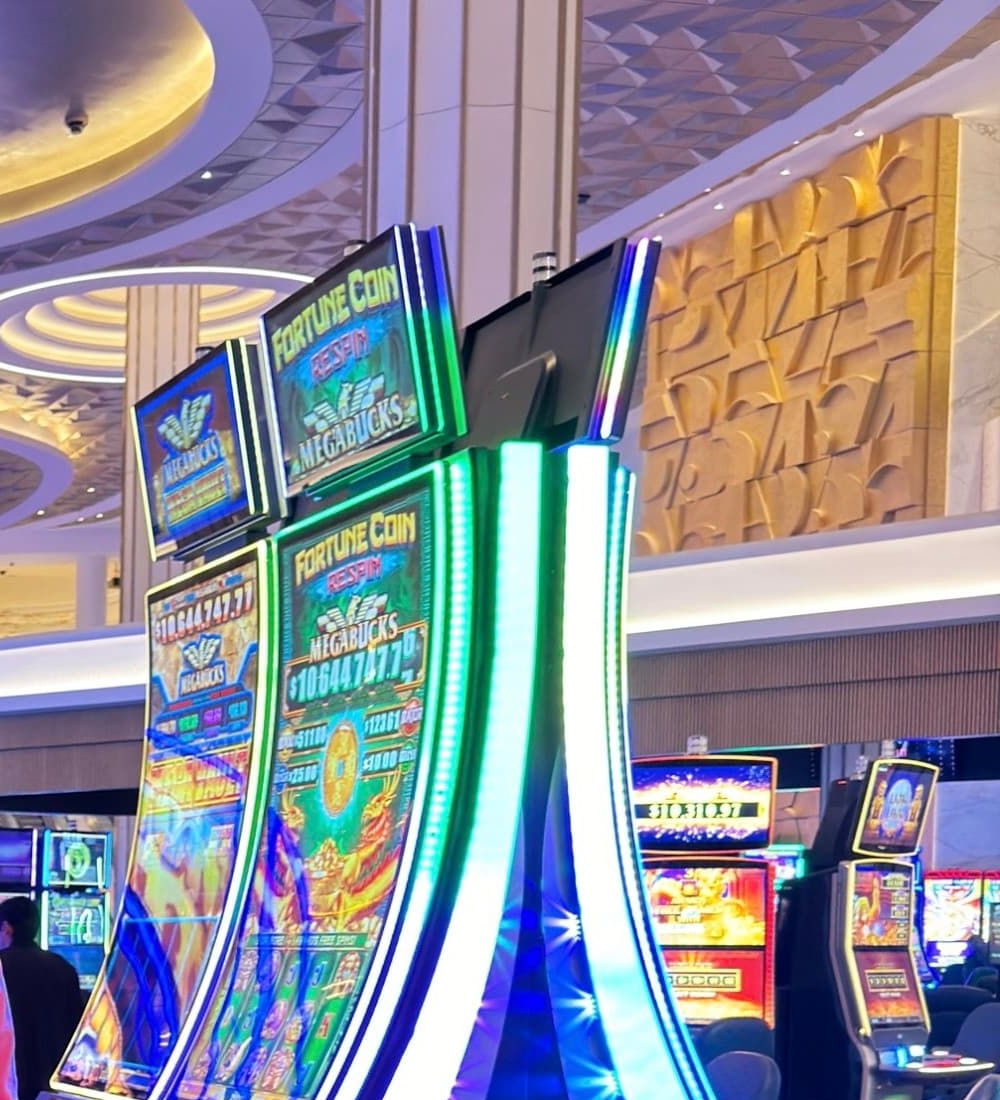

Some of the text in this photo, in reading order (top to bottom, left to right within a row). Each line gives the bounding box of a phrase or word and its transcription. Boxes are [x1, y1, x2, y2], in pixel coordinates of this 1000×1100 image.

[272, 266, 399, 372] FORTUNE COIN
[299, 394, 404, 473] MEGABUCKS
[295, 511, 415, 586] FORTUNE COIN
[309, 612, 398, 663] MEGABUCKS
